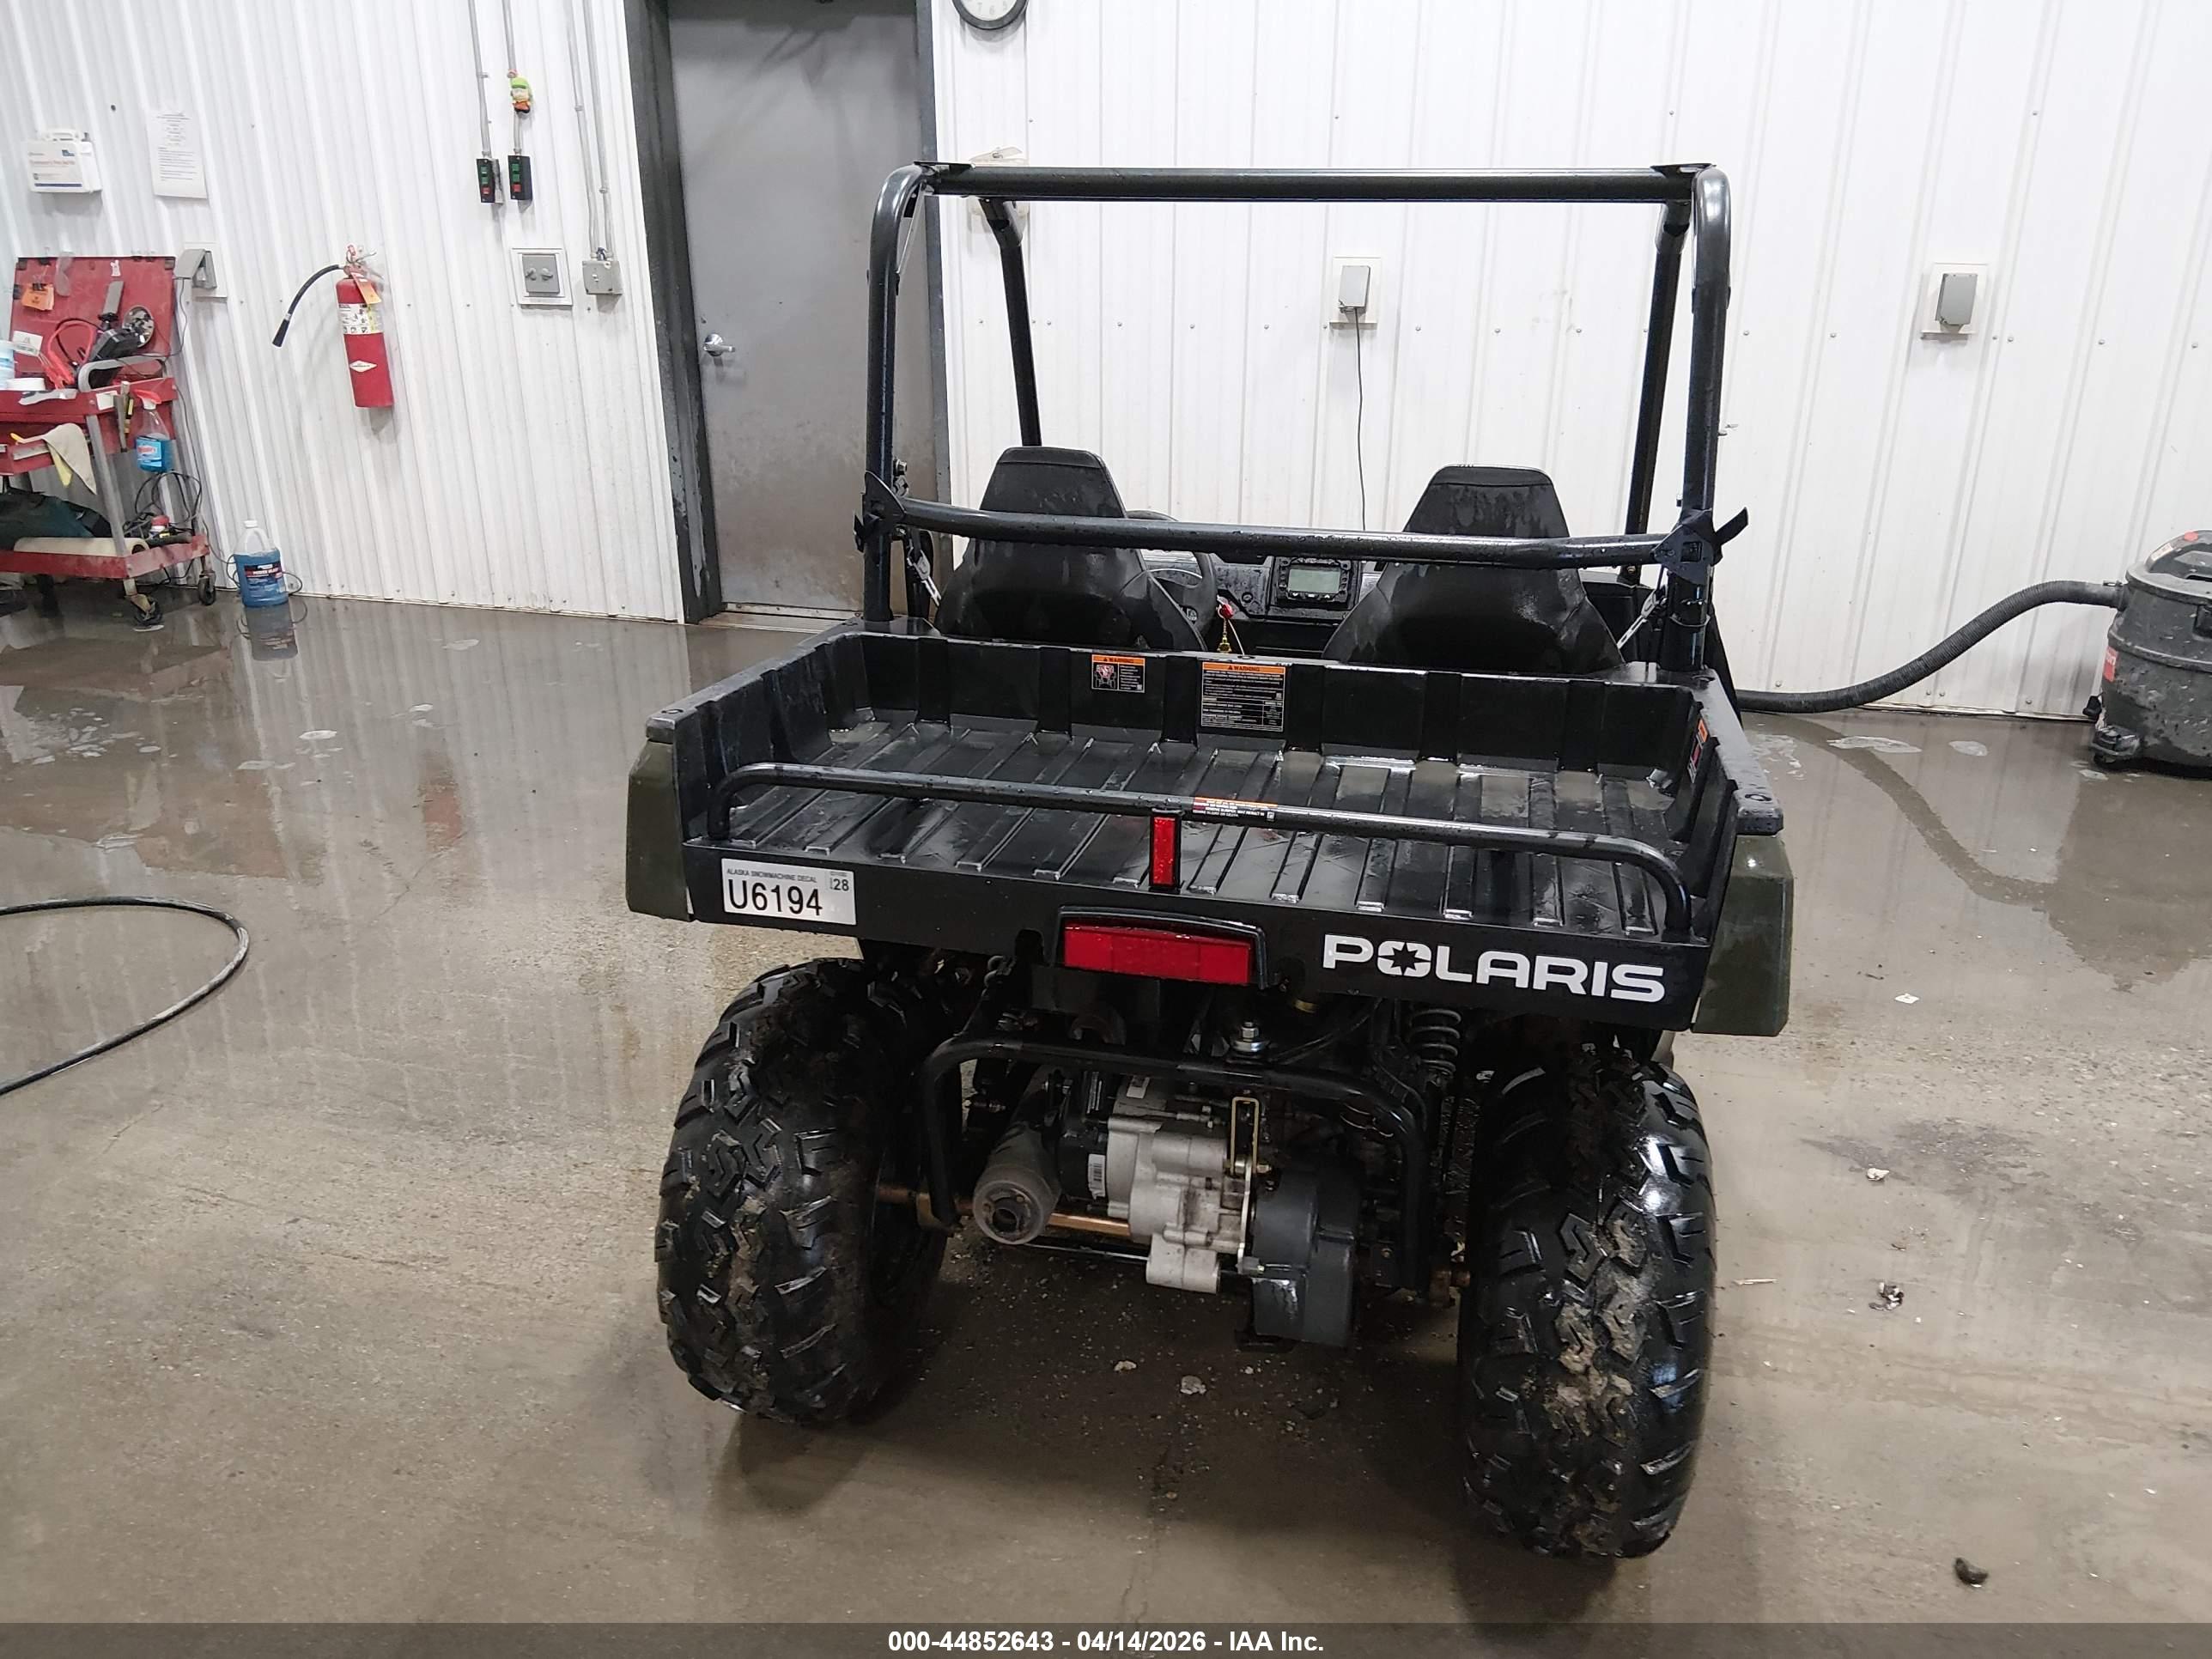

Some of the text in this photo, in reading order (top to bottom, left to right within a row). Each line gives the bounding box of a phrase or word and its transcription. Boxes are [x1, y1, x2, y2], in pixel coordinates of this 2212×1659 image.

[726, 868, 750, 877] ALASKA
[797, 874, 817, 884] DECAL
[833, 878, 849, 891] 28
[728, 878, 823, 916] U6194
[1322, 933, 1666, 1003] POLARIS
